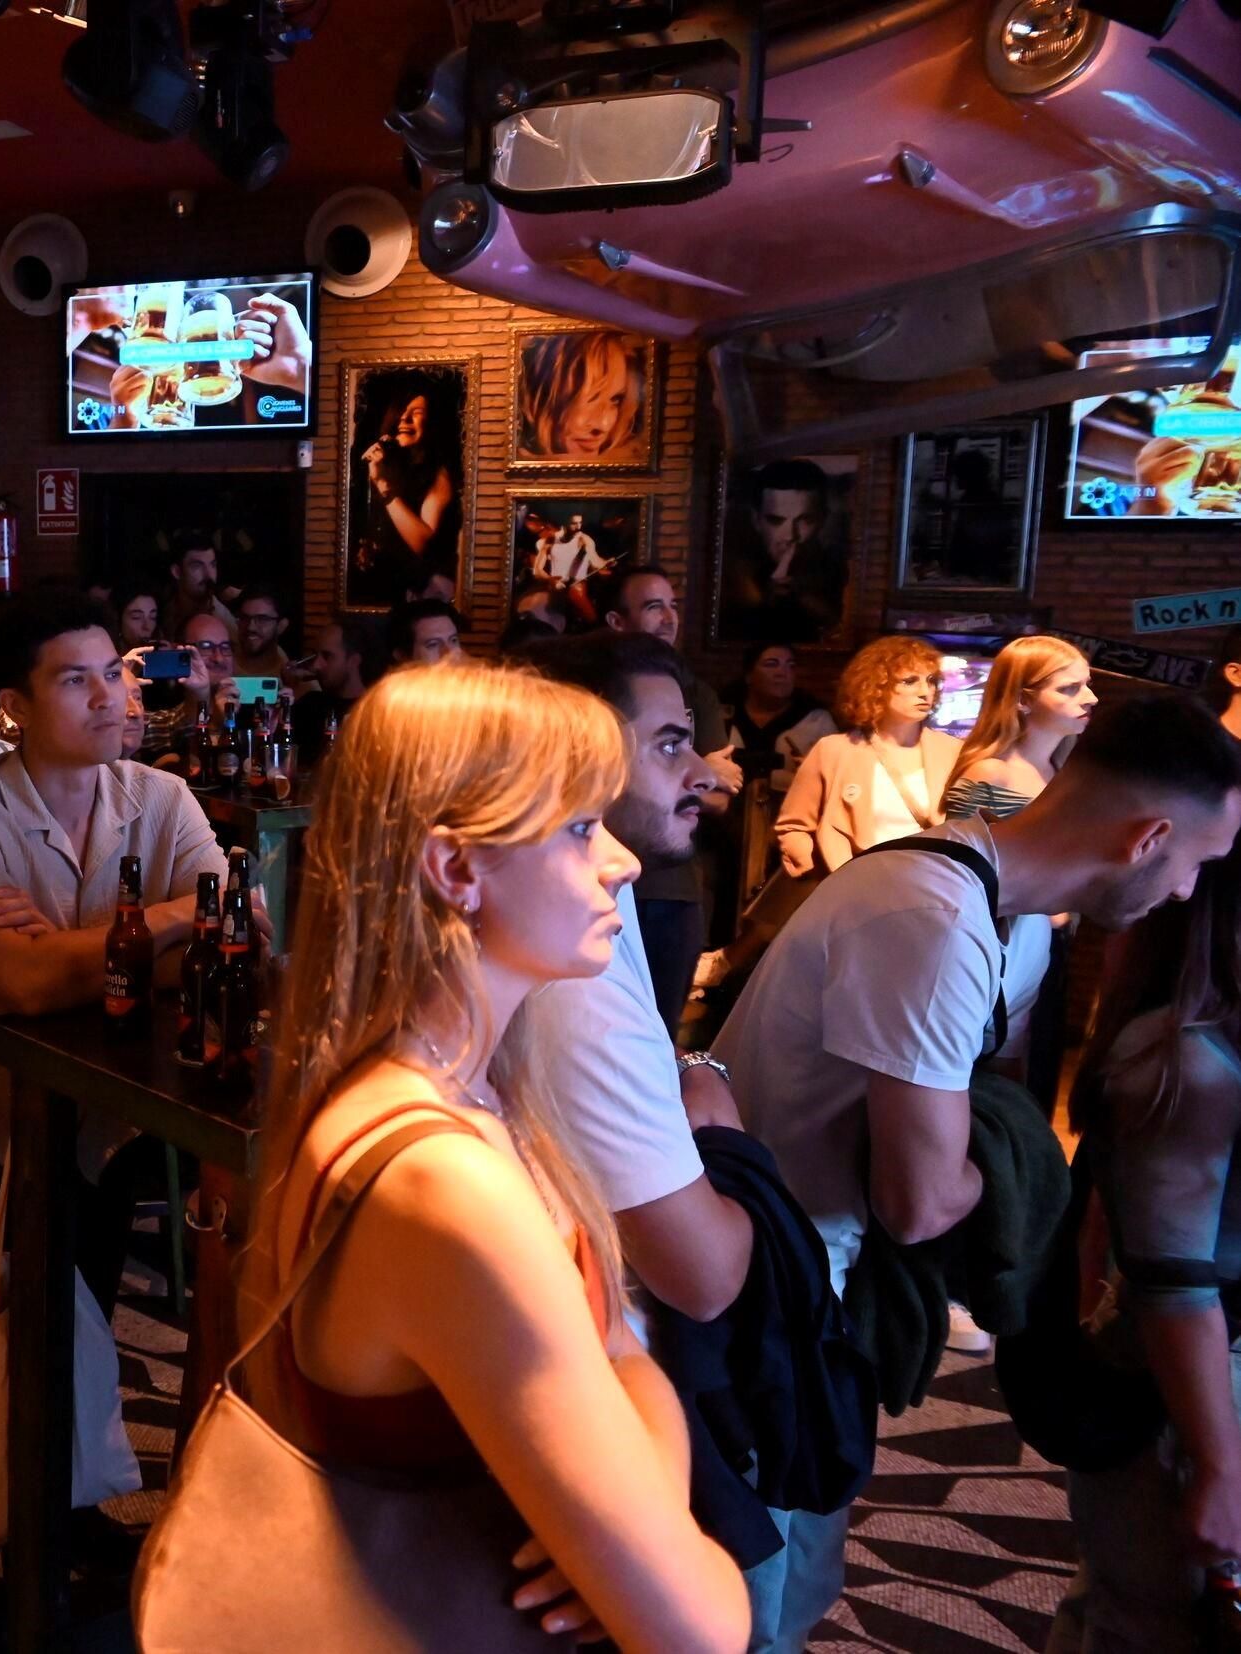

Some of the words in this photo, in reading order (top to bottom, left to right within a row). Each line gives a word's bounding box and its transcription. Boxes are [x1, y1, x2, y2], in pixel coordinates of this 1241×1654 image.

[1119, 486, 1157, 497] ARN
[41, 520, 76, 529] EXTINTOR
[1140, 599, 1211, 627] Rock
